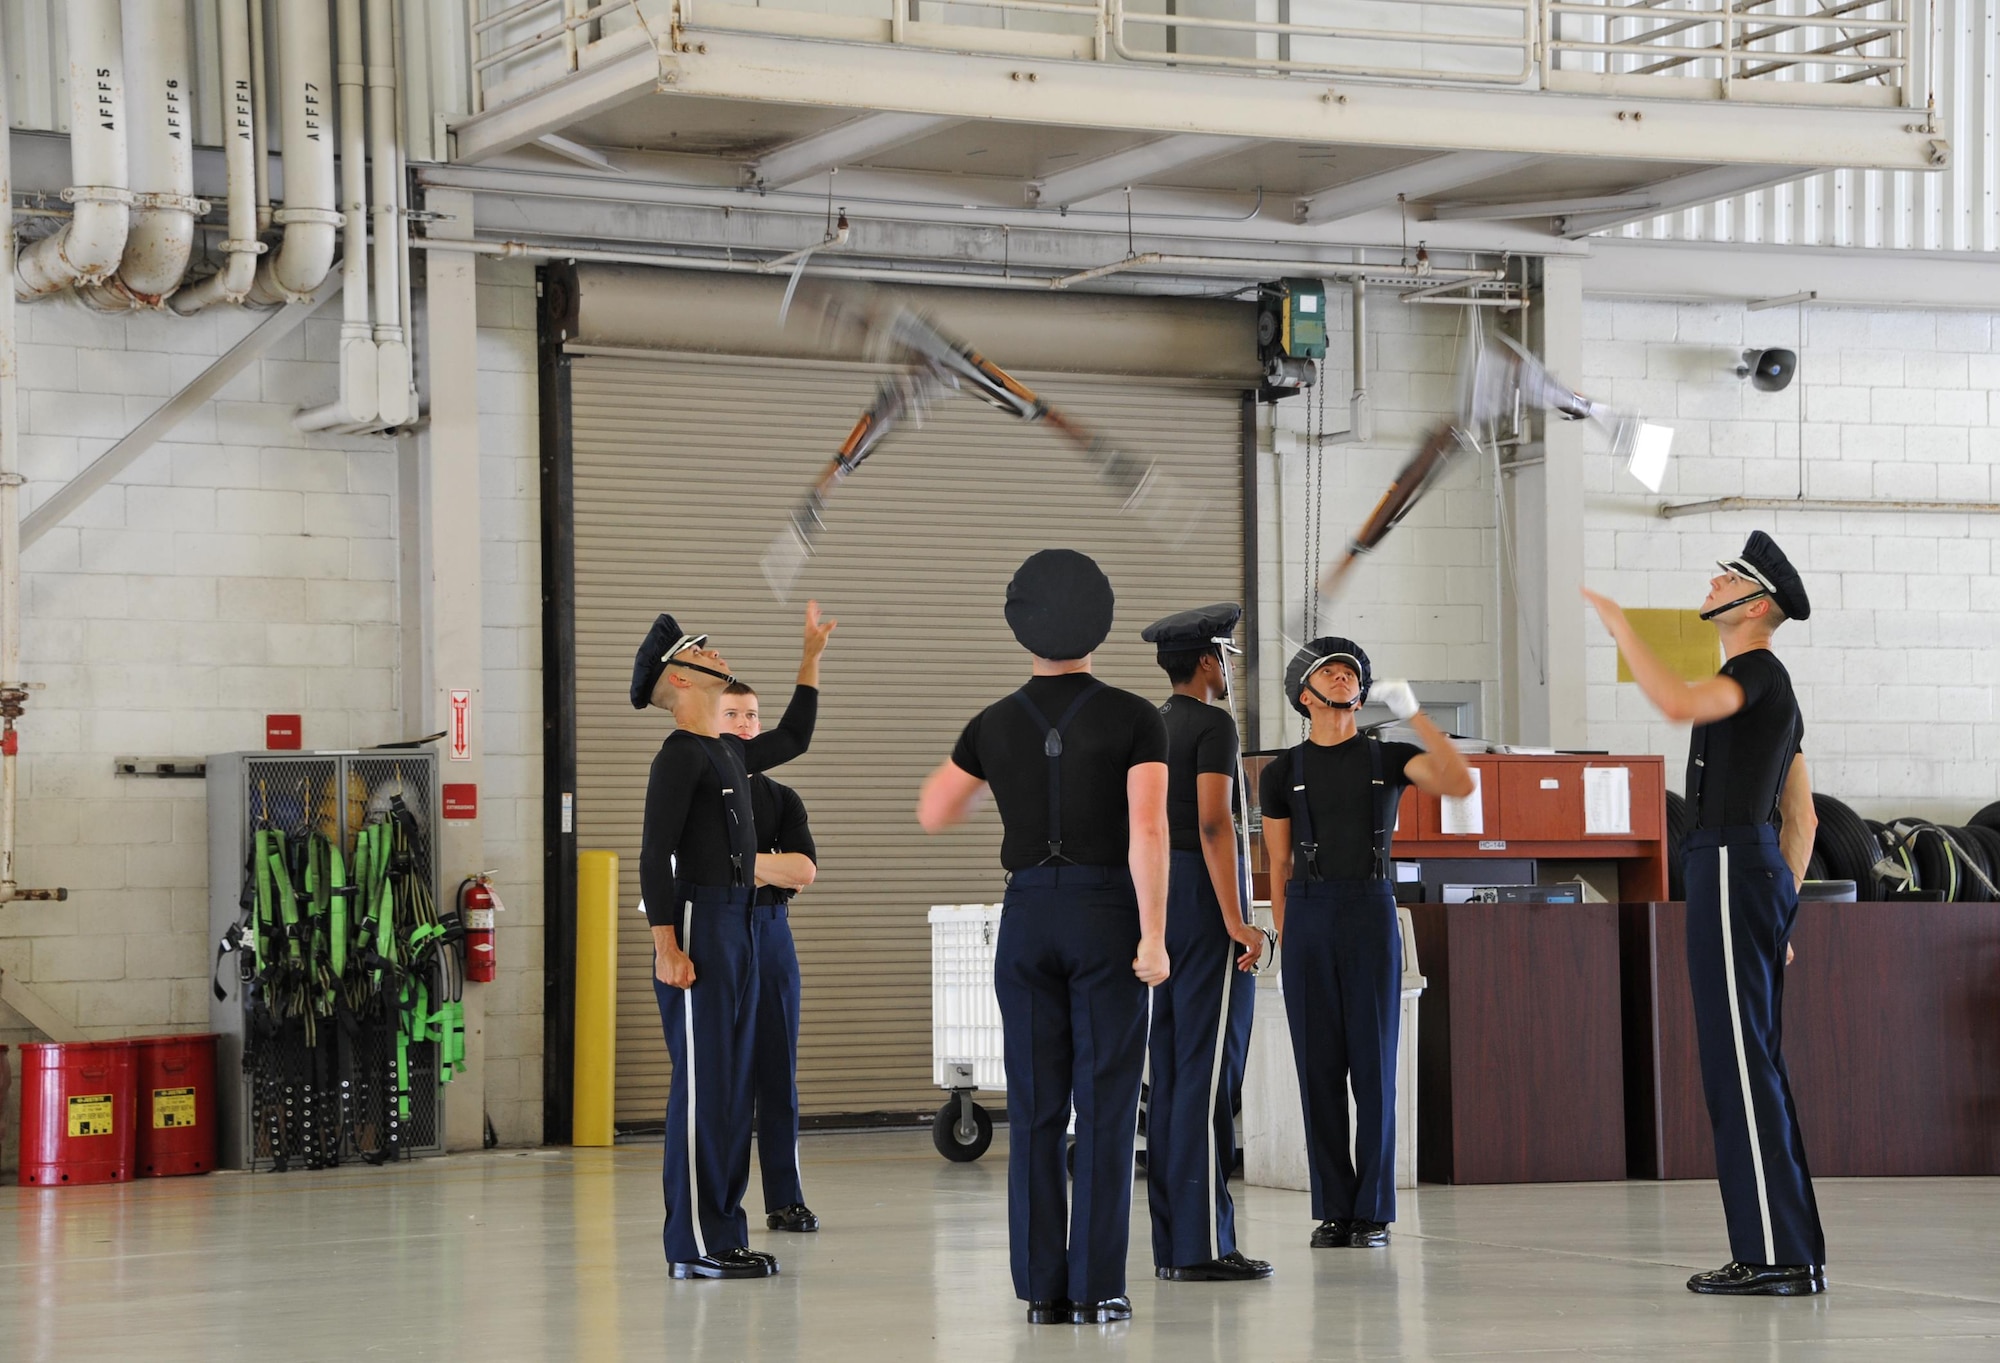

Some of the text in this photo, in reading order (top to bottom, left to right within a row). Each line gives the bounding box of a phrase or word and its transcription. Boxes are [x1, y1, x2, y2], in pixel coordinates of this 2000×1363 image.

[97, 68, 115, 131] AFFF5
[167, 79, 181, 140] AFFF6
[236, 80, 251, 140] AFFFH
[305, 82, 320, 142] AFFF7
